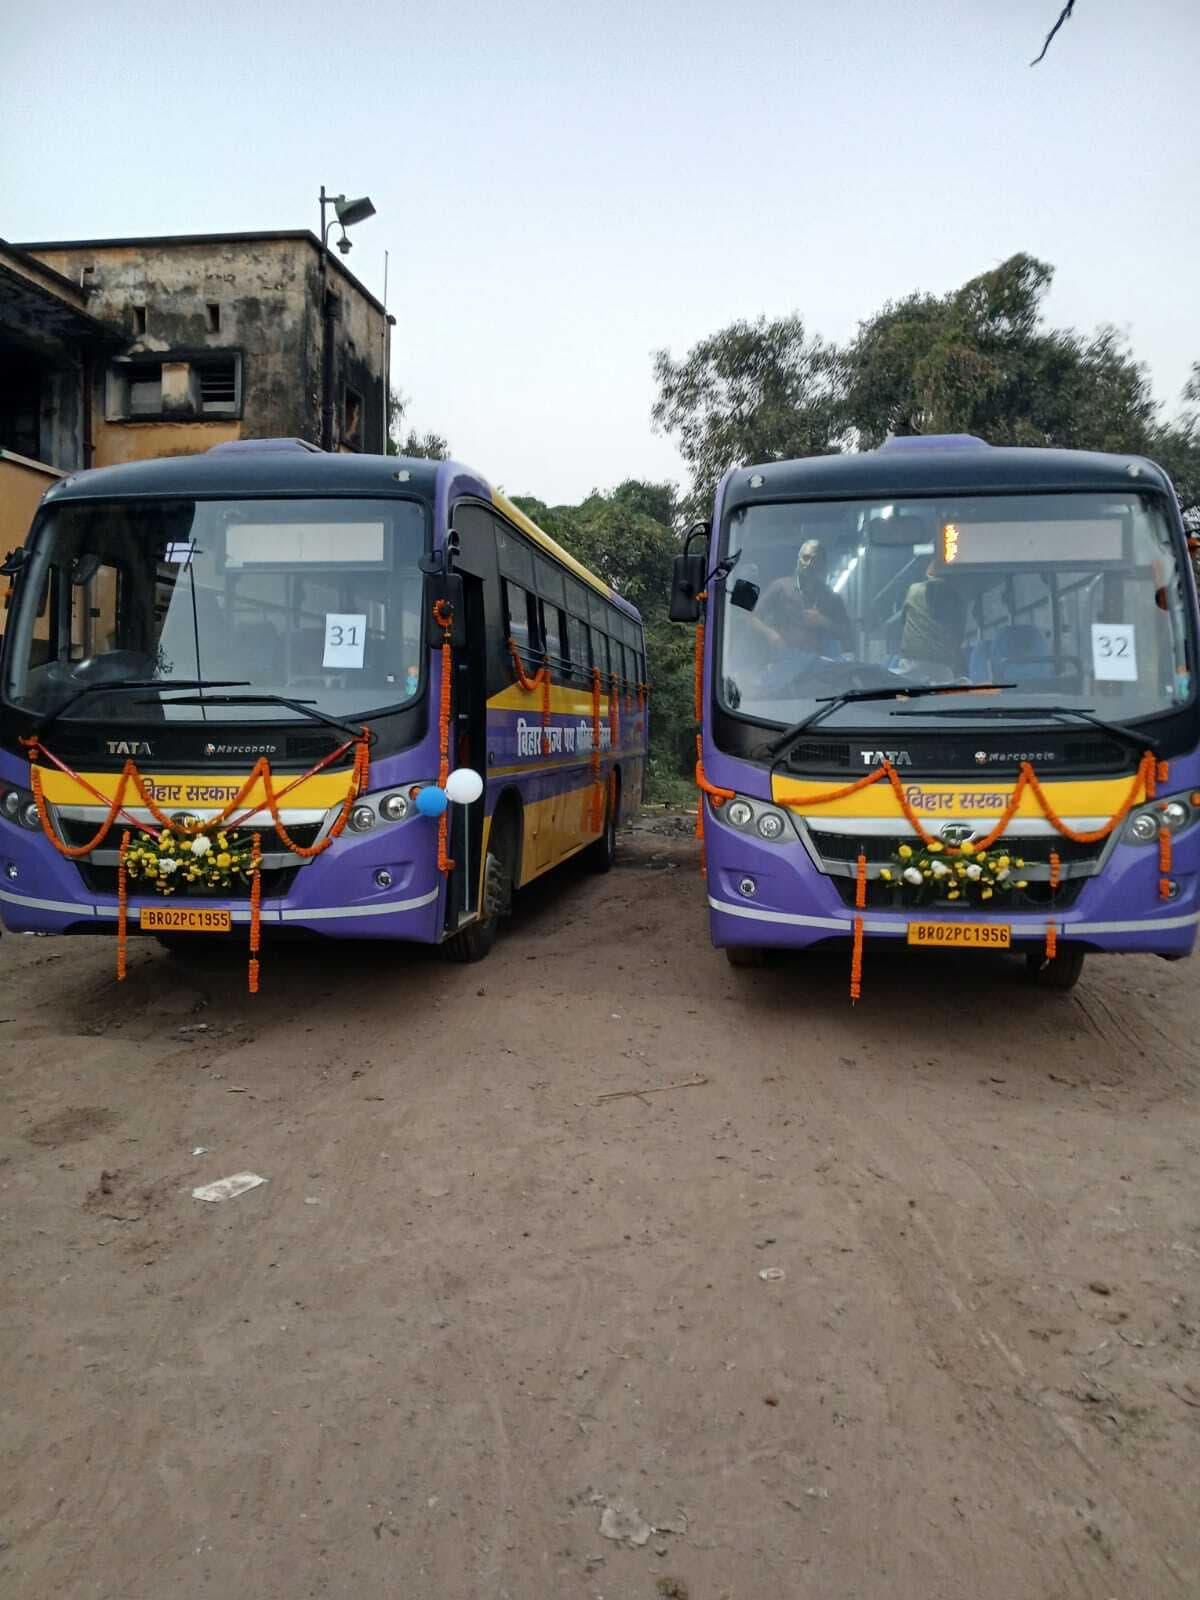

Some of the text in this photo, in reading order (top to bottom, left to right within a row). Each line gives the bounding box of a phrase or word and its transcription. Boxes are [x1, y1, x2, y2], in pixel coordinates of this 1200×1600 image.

[330, 625, 360, 647] 31
[1098, 636, 1130, 658] 32
[106, 741, 153, 755] TATA
[861, 751, 912, 765] TATA
[905, 786, 954, 811] बिहार
[149, 911, 228, 927] BR02PC1955
[918, 926, 1008, 942] BR02PC1956
